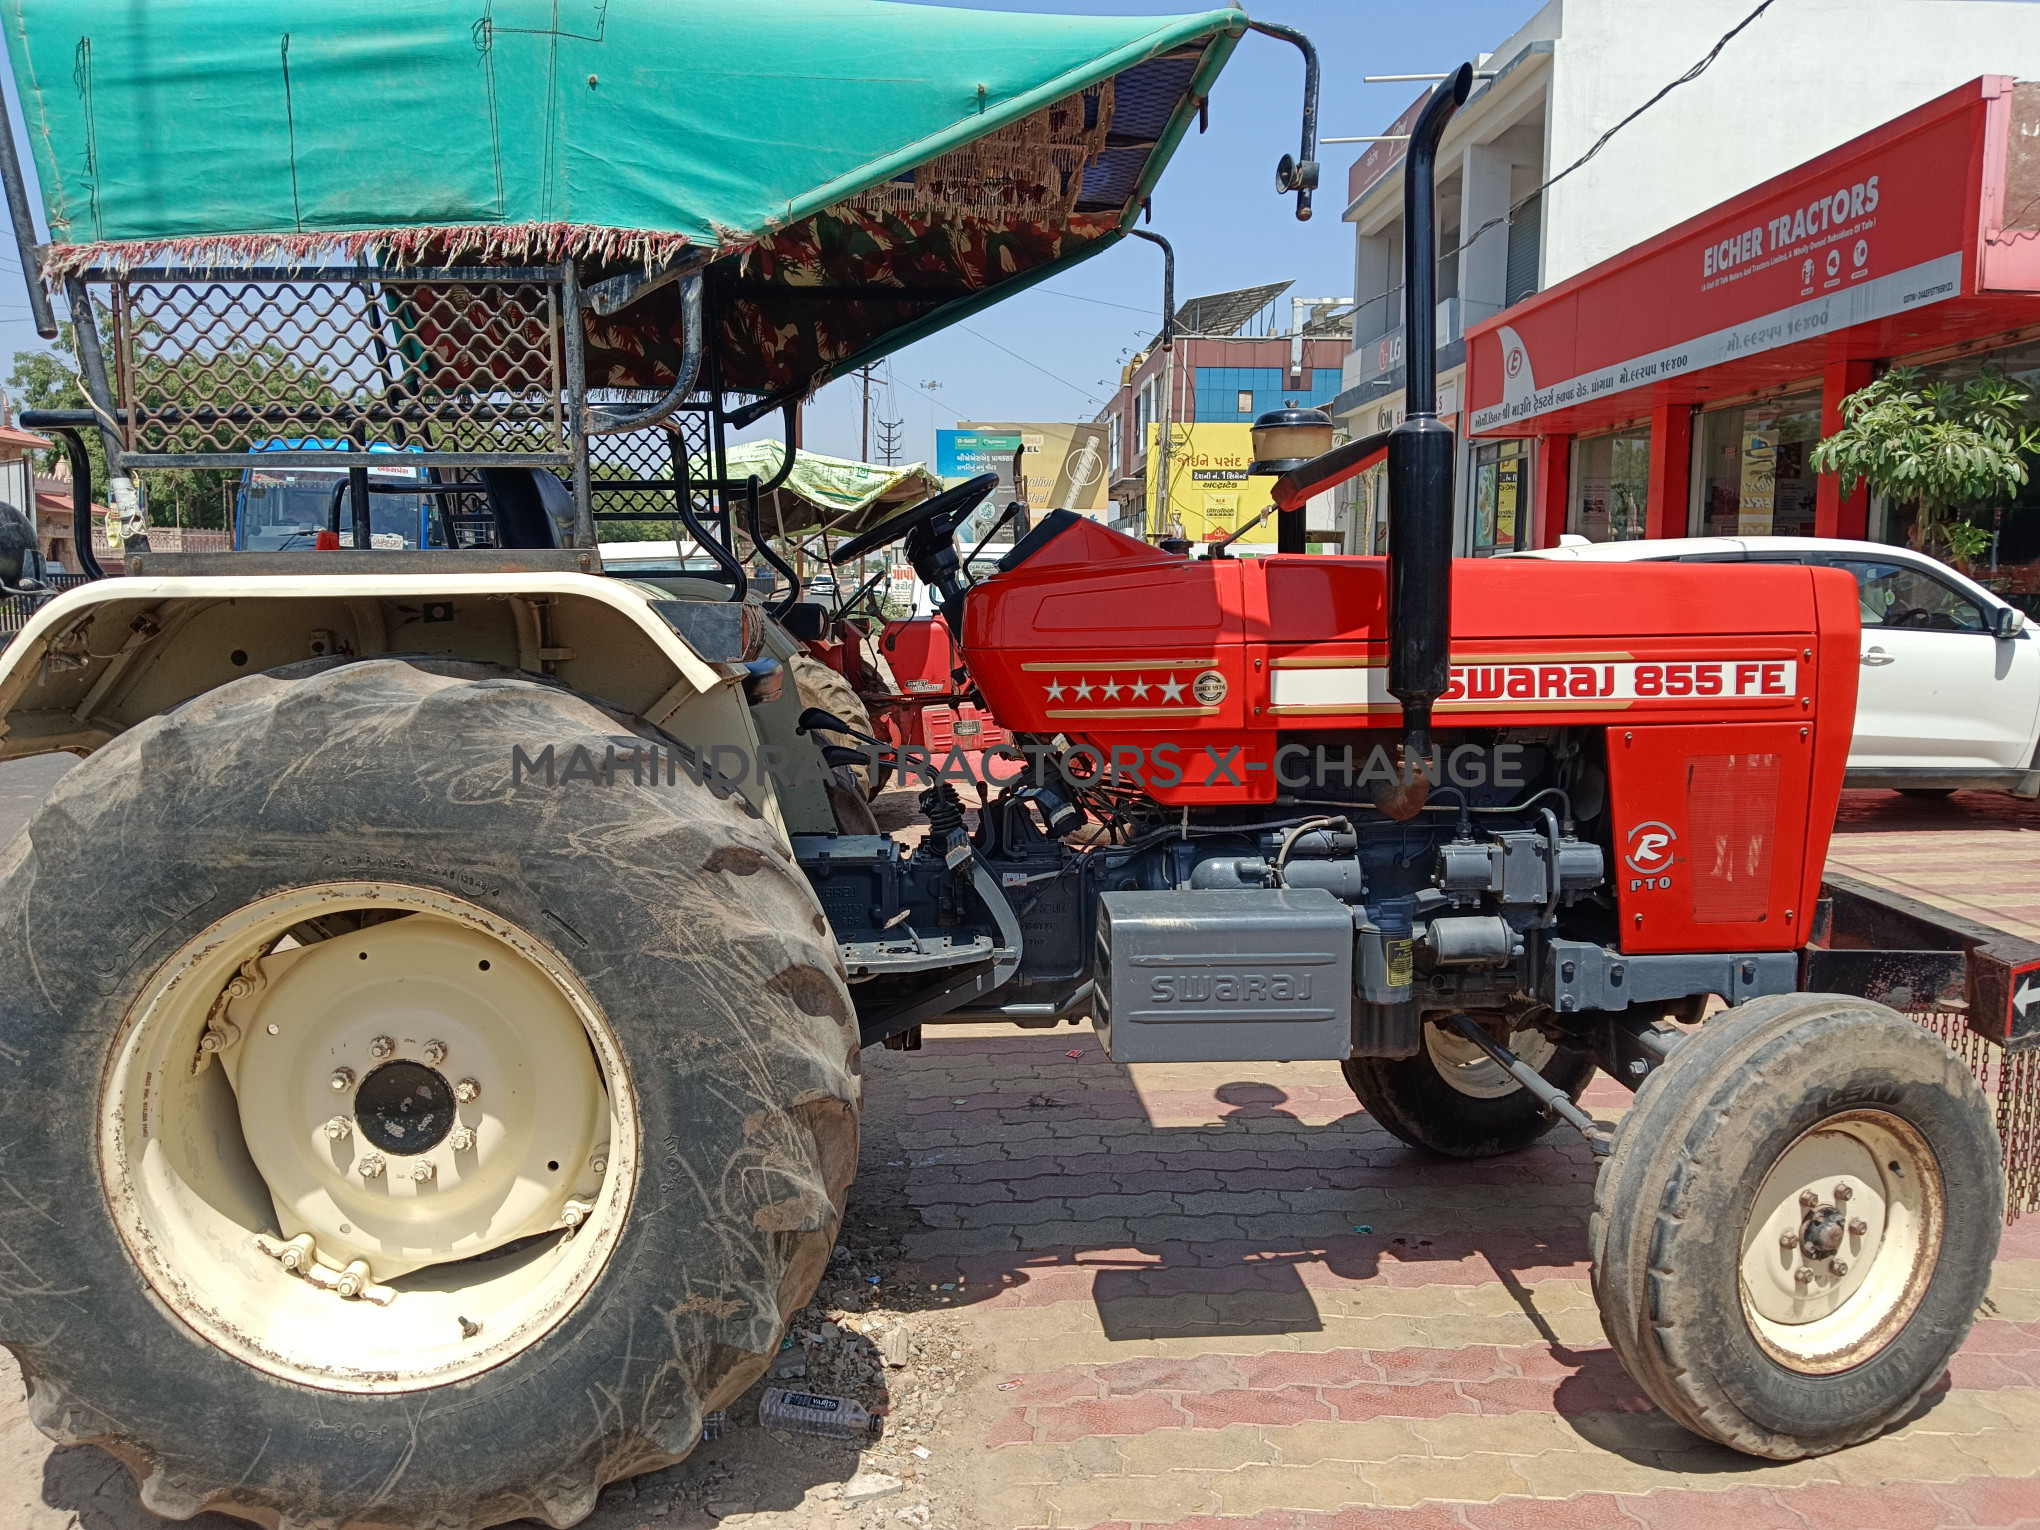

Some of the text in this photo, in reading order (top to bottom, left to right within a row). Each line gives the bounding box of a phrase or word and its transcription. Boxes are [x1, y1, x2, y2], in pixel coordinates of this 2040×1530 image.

[1703, 175, 1880, 277] EICHER TRACTORS
[1720, 276, 1728, 285] Tafe
[1729, 271, 1743, 282] Motors
[1744, 266, 1752, 276] And
[1752, 261, 1770, 272] Tractors
[1794, 244, 1809, 257] Wholly
[1810, 236, 1827, 250] Owned
[1854, 224, 1861, 234] Of
[1389, 336, 1401, 363] LG
[1214, 453, 1242, 467] પસંદ
[1438, 663, 1787, 700] SWARAJ 855 FE
[378, 856, 415, 870] NYLON
[1630, 876, 1672, 892] PTO
[1151, 973, 1313, 1003] SWARAJ
